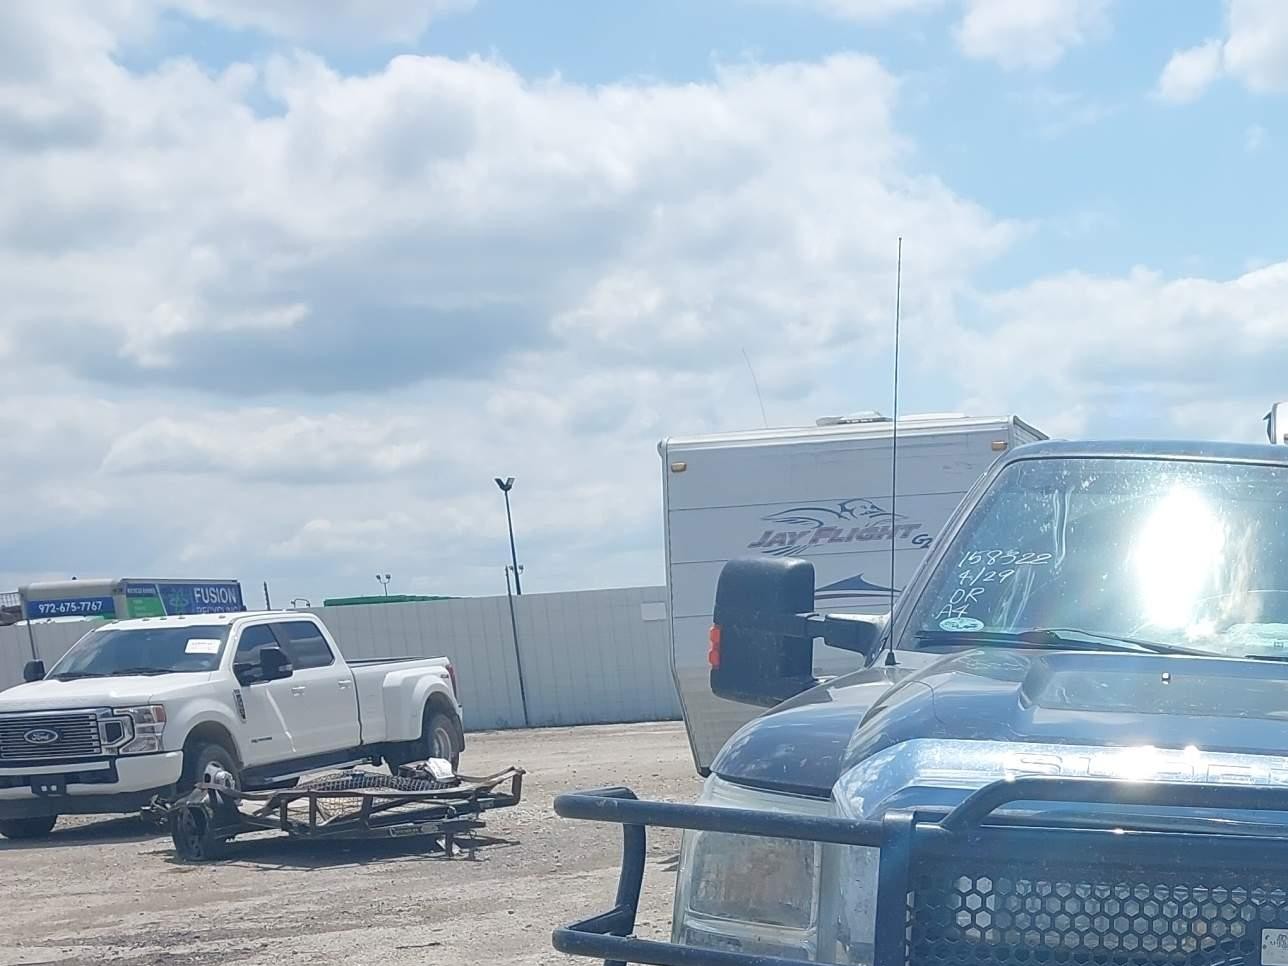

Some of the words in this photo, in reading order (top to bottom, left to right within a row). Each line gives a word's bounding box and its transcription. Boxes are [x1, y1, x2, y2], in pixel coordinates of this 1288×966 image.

[748, 530, 812, 549] JAY
[807, 523, 922, 545] FLIGHT
[959, 566, 1015, 586] 4/29
[193, 587, 237, 603] FUSION
[38, 600, 103, 614] 972-675-7767
